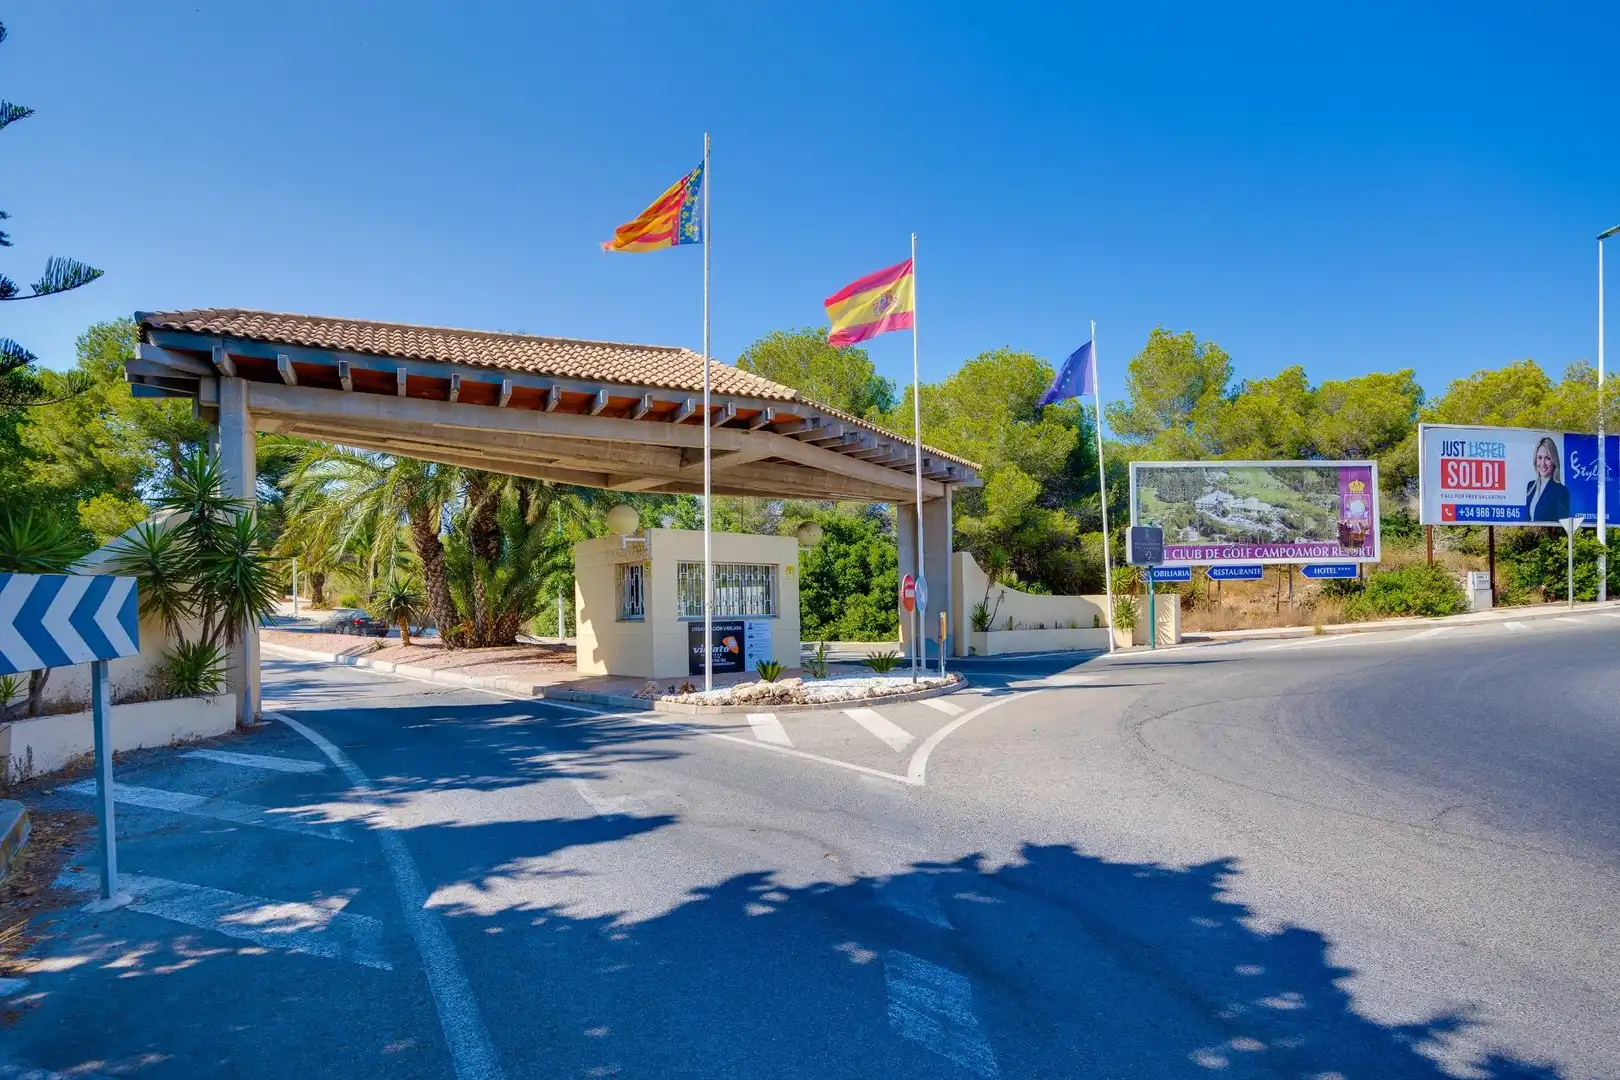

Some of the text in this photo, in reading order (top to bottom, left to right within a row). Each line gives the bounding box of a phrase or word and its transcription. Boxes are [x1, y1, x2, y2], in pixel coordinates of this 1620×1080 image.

[1441, 441, 1466, 457] JUST
[1447, 461, 1500, 488] SOLD!
[1458, 507, 1475, 517] +34
[1491, 507, 1505, 518] 799
[1506, 507, 1521, 518] 645
[1172, 548, 1202, 559] CLUB
[1205, 548, 1220, 559] DE
[1222, 547, 1252, 559] GOLF
[1254, 547, 1329, 558] CAMPOAMOR
[1213, 567, 1261, 576] RESTAURANTE
[1314, 567, 1337, 575] HOTEL
[693, 644, 729, 653] viato
